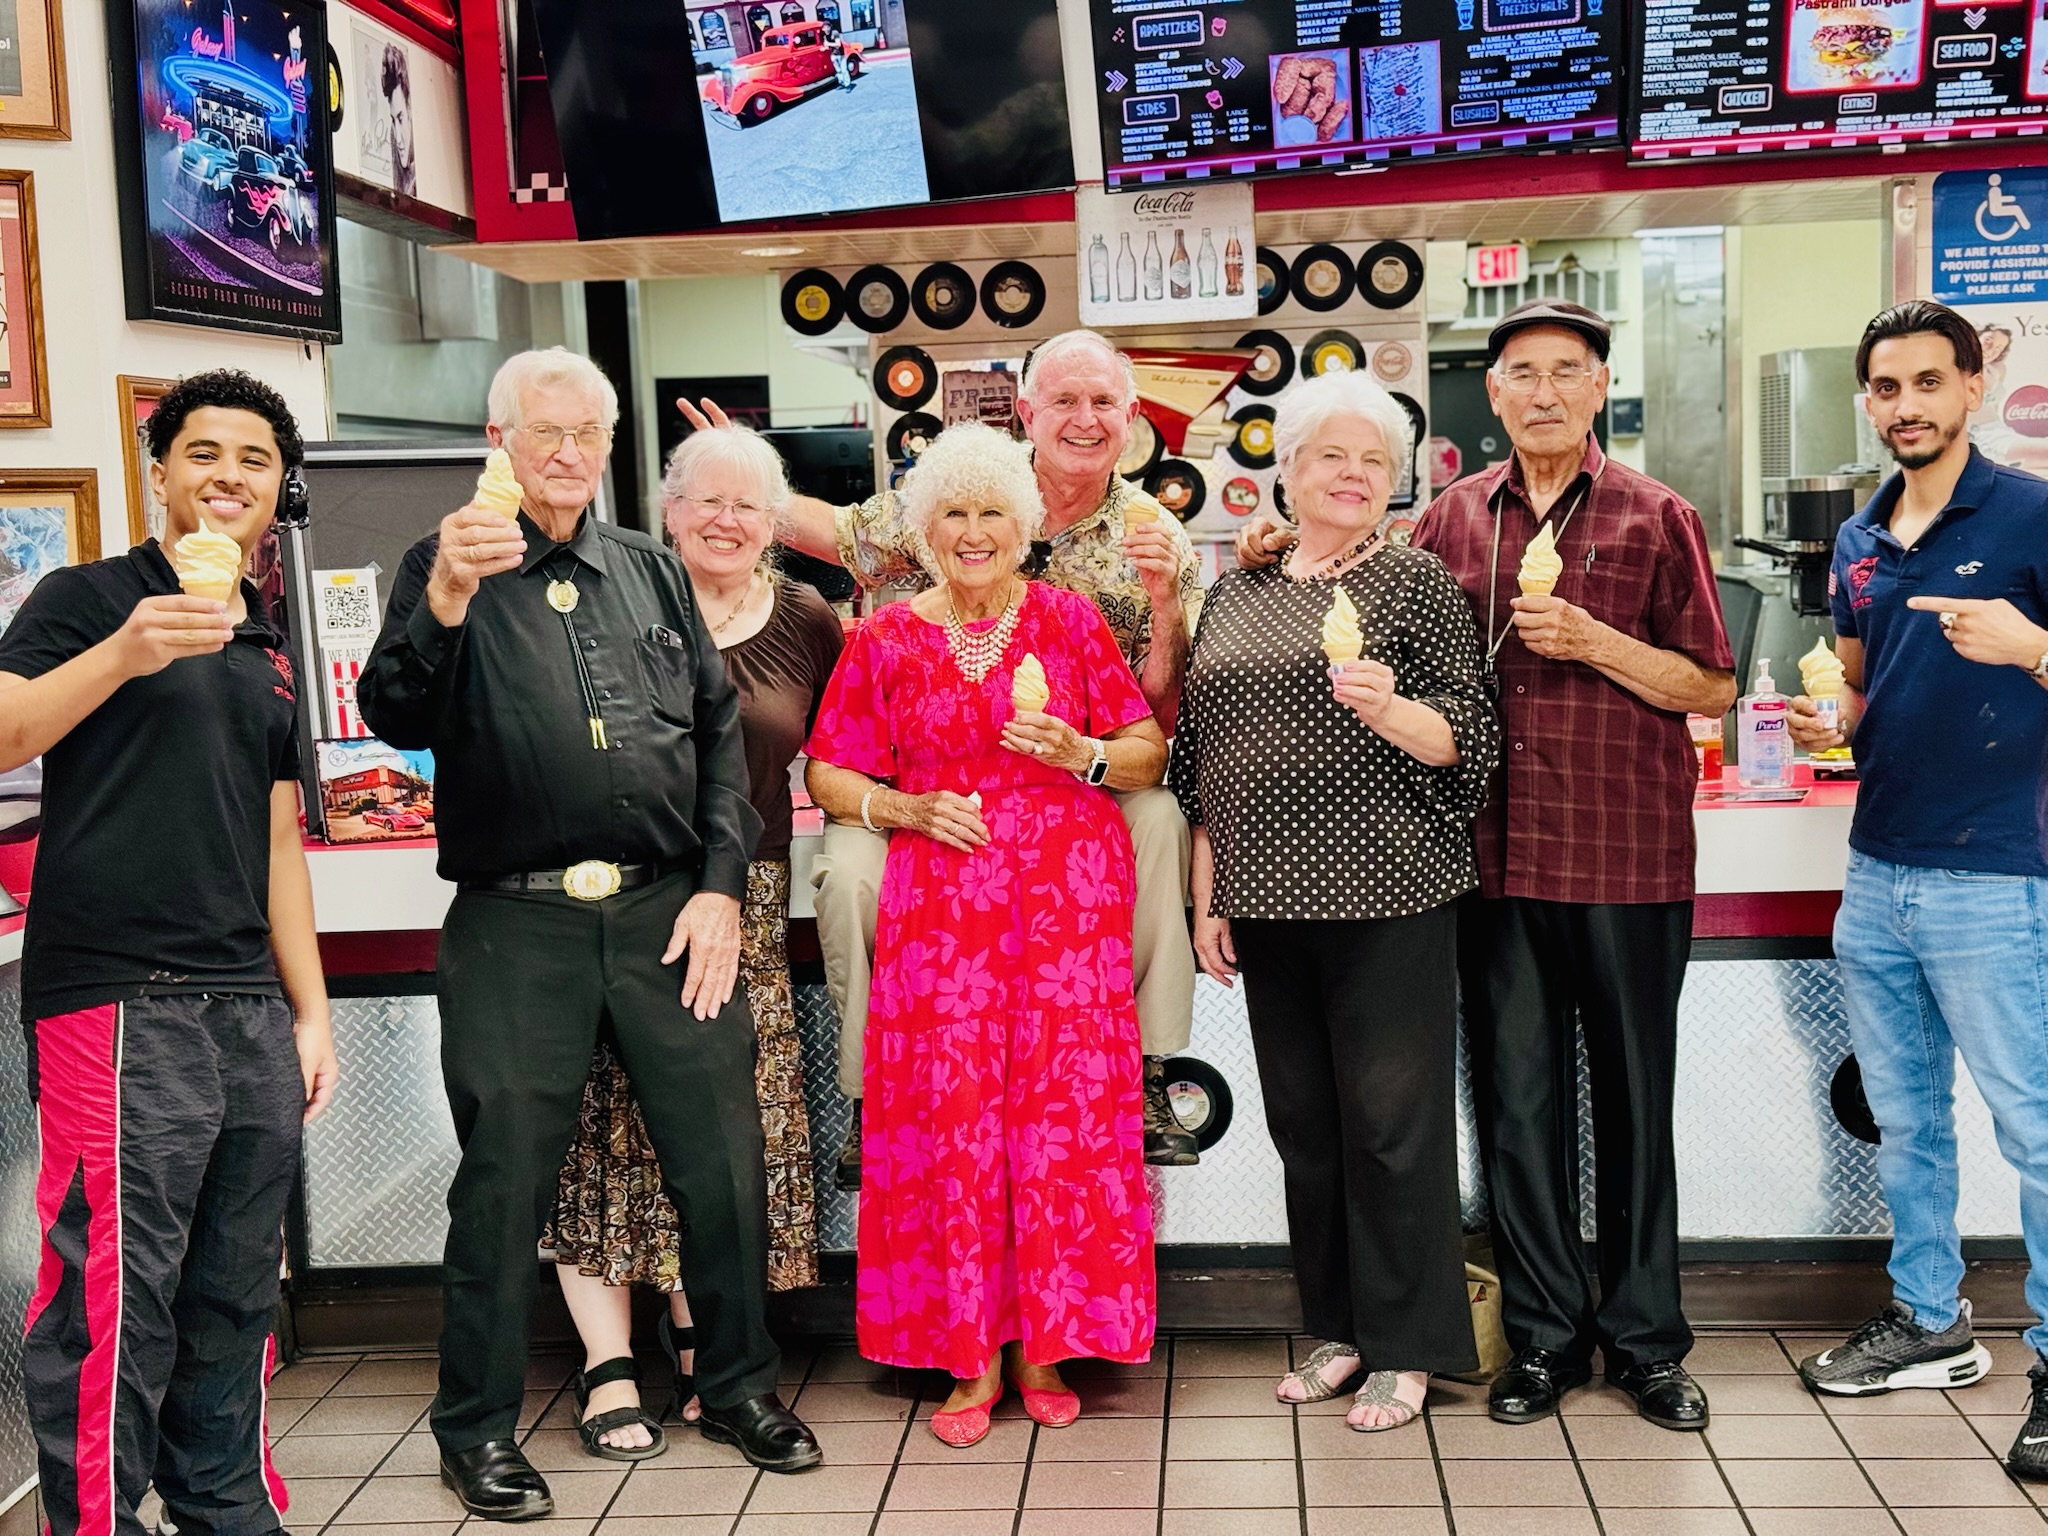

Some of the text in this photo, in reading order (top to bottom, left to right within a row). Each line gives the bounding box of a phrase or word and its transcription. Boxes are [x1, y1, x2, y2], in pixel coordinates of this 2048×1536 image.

[1296, 19, 1326, 28] BANANA
[1664, 16, 1688, 24] ONION
[1712, 12, 1738, 21] BACON
[1140, 20, 1200, 38] APPETIZERS
[1709, 28, 1738, 37] CHEESE
[1940, 42, 1989, 58] SEA FOOD
[1722, 91, 1766, 107] CHICKEN
[1136, 102, 1166, 116] SIDES
[1226, 109, 1248, 117] LARGE
[1454, 106, 1496, 121] SLUSHIES
[1944, 248, 1962, 258] WE
[1964, 246, 1987, 258] ARE
[1989, 244, 2040, 256] PLEASED
[1478, 246, 1518, 281] EXIT
[1940, 256, 2048, 272] PROVIDE ASSISTAN
[1950, 274, 1962, 284] IF
[1963, 272, 1988, 283] YOU
[1989, 271, 2020, 282] NEED
[1966, 282, 2036, 296] PLEASE ASK
[171, 282, 208, 300] SCENES
[287, 302, 323, 318] AMERICA
[328, 650, 343, 662] WE
[345, 648, 362, 662] ARE
